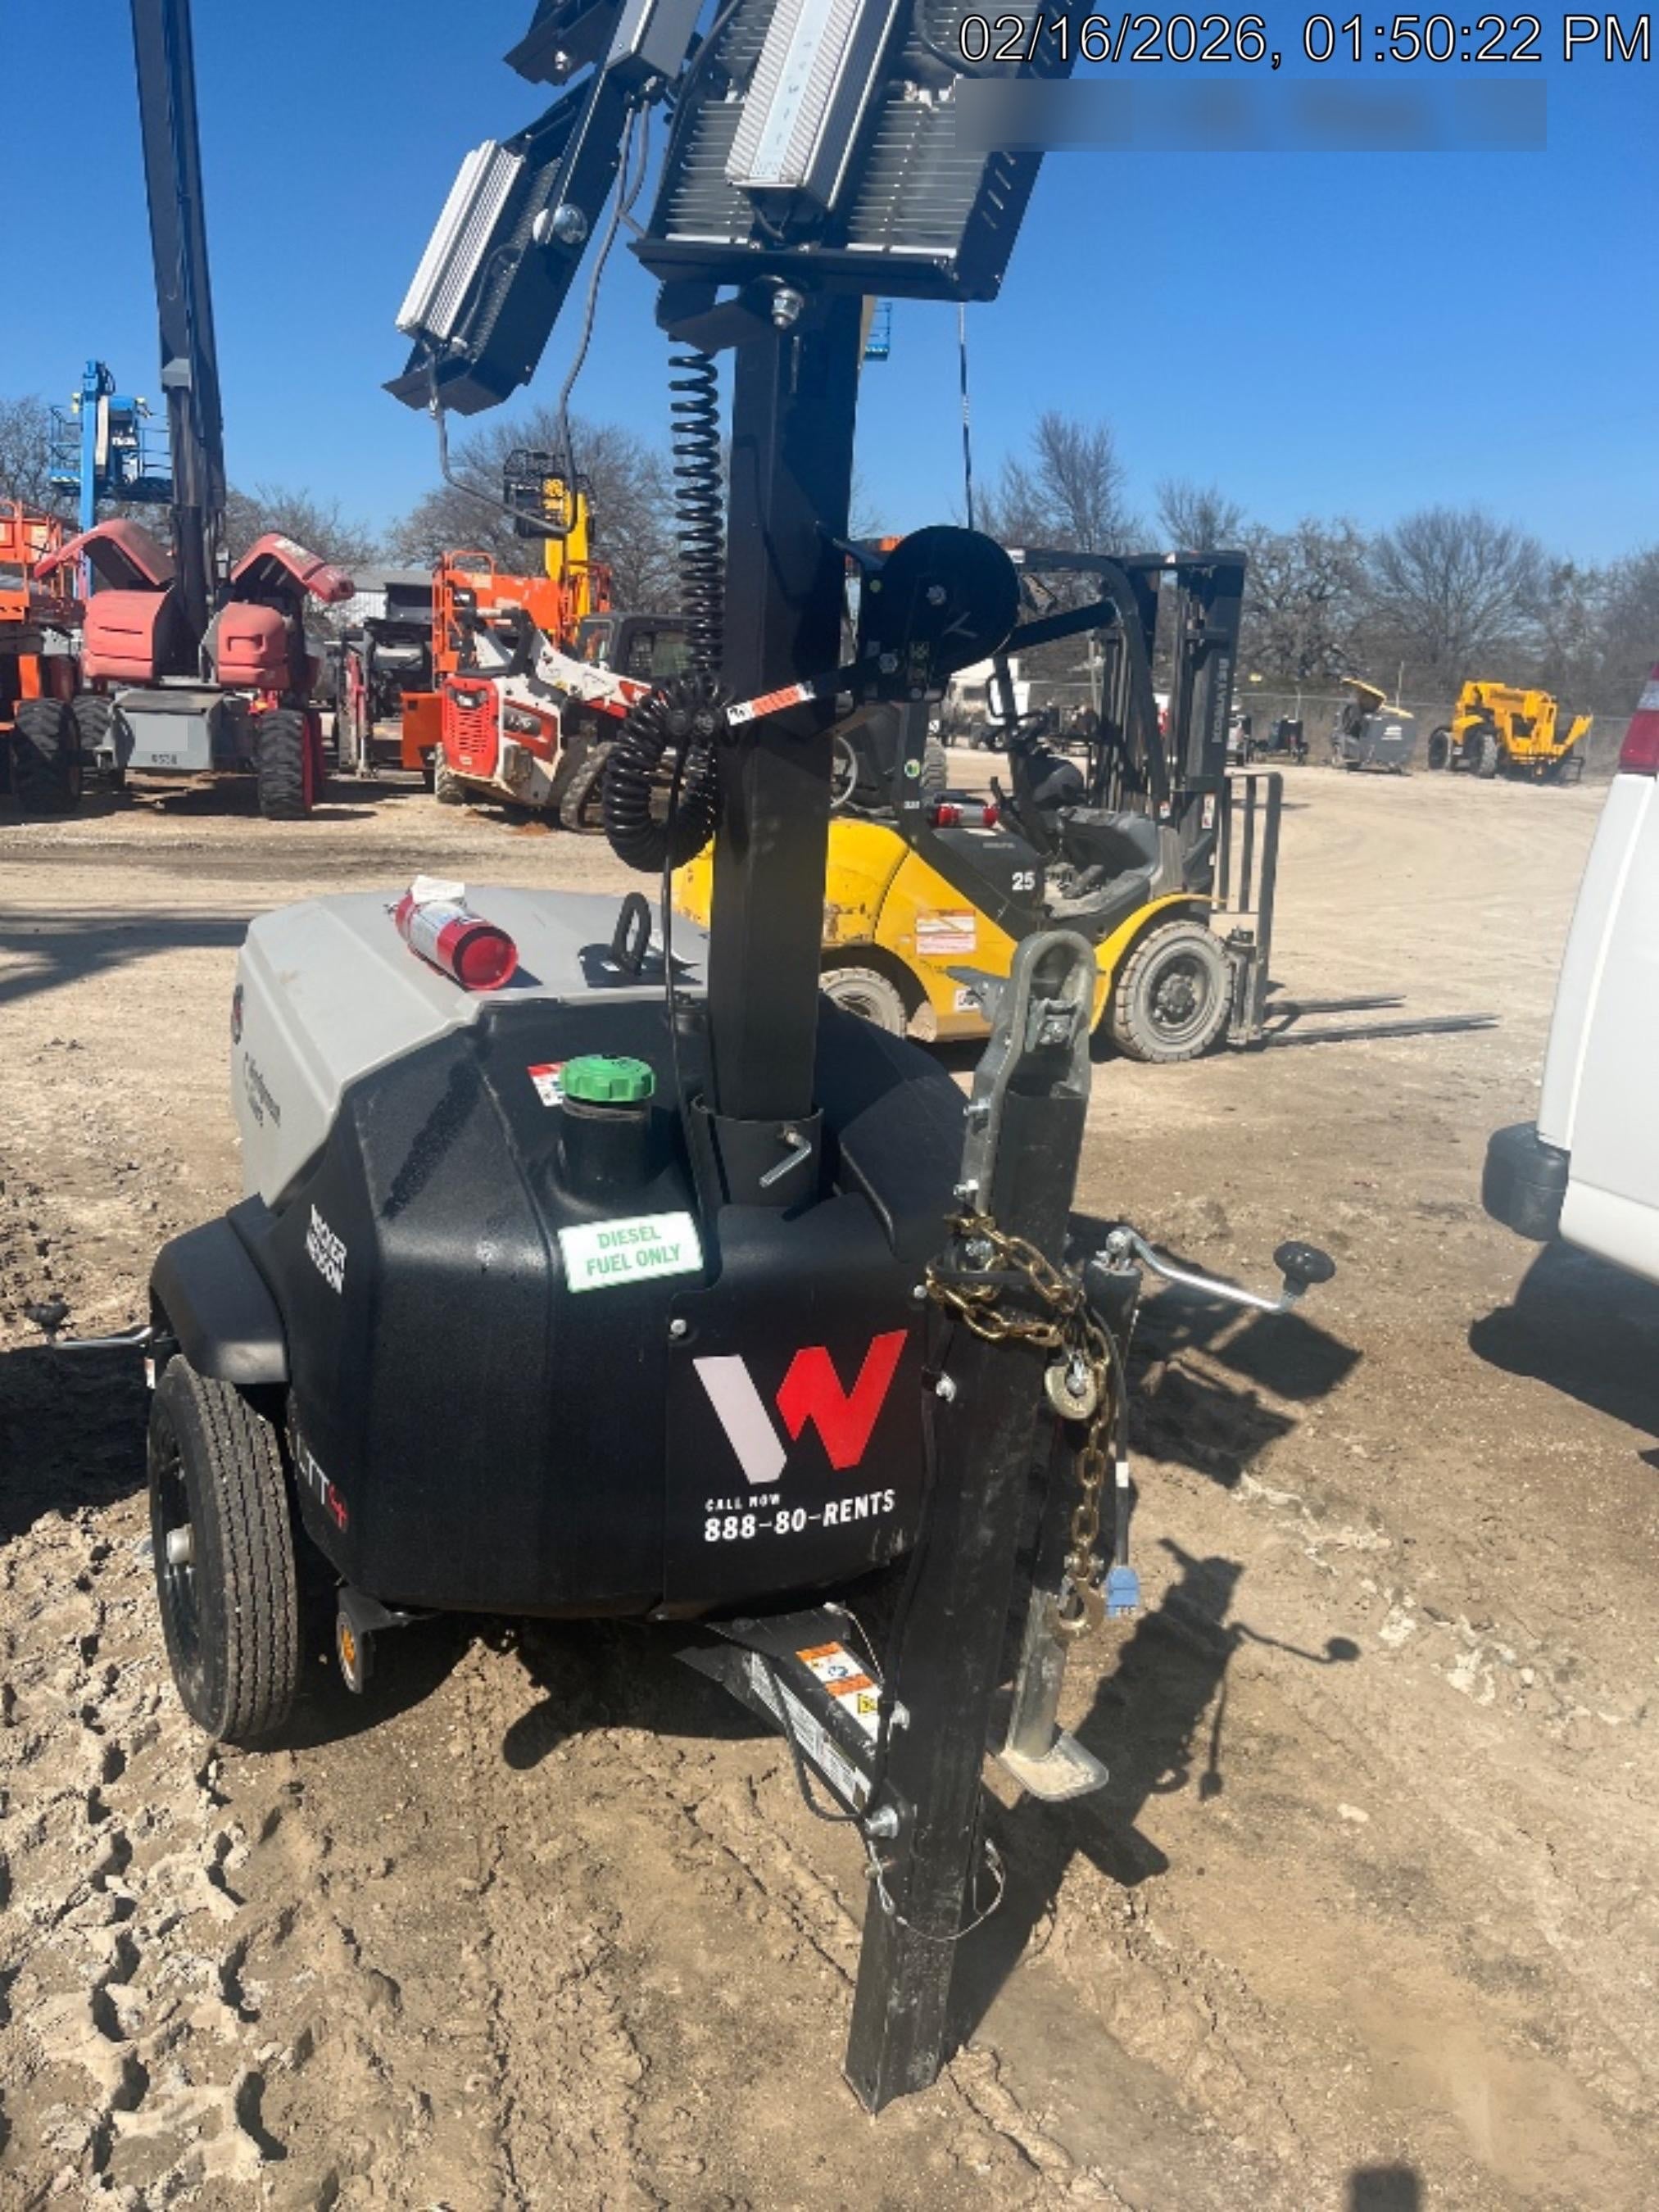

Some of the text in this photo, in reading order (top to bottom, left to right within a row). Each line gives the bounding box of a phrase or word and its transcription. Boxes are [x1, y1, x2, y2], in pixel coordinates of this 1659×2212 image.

[1012, 872, 1036, 891] 25
[597, 1226, 662, 1249] DIESEL
[587, 1244, 681, 1276] FUEL ONLY
[692, 1329, 909, 1485] W
[705, 1494, 781, 1512] CALL NOW
[705, 1488, 895, 1542] 888-80-RENTS
